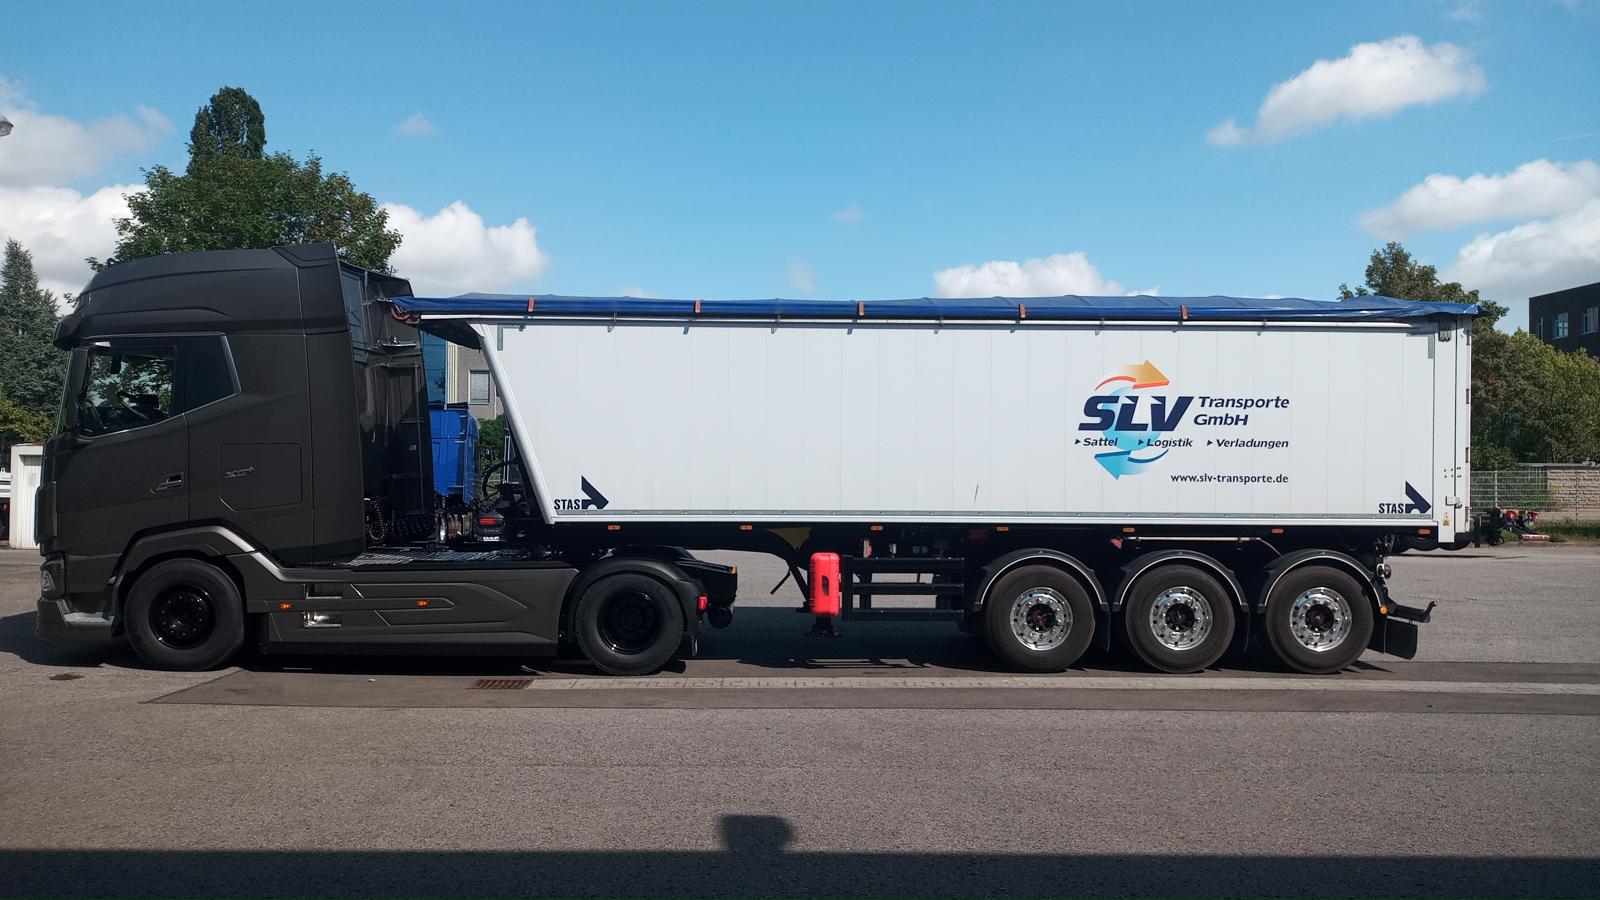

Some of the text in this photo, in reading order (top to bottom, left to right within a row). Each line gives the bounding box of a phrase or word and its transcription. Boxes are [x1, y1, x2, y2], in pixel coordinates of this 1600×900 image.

[1199, 396, 1290, 409] Transporte
[1078, 396, 1194, 431] SLV
[1193, 414, 1248, 426] GmbH
[1083, 437, 1289, 449] Sattel Logistik Verladungen
[1170, 473, 1289, 485] www.slv-transporte.de
[554, 499, 580, 510] STAS
[1379, 503, 1404, 513] STAS
